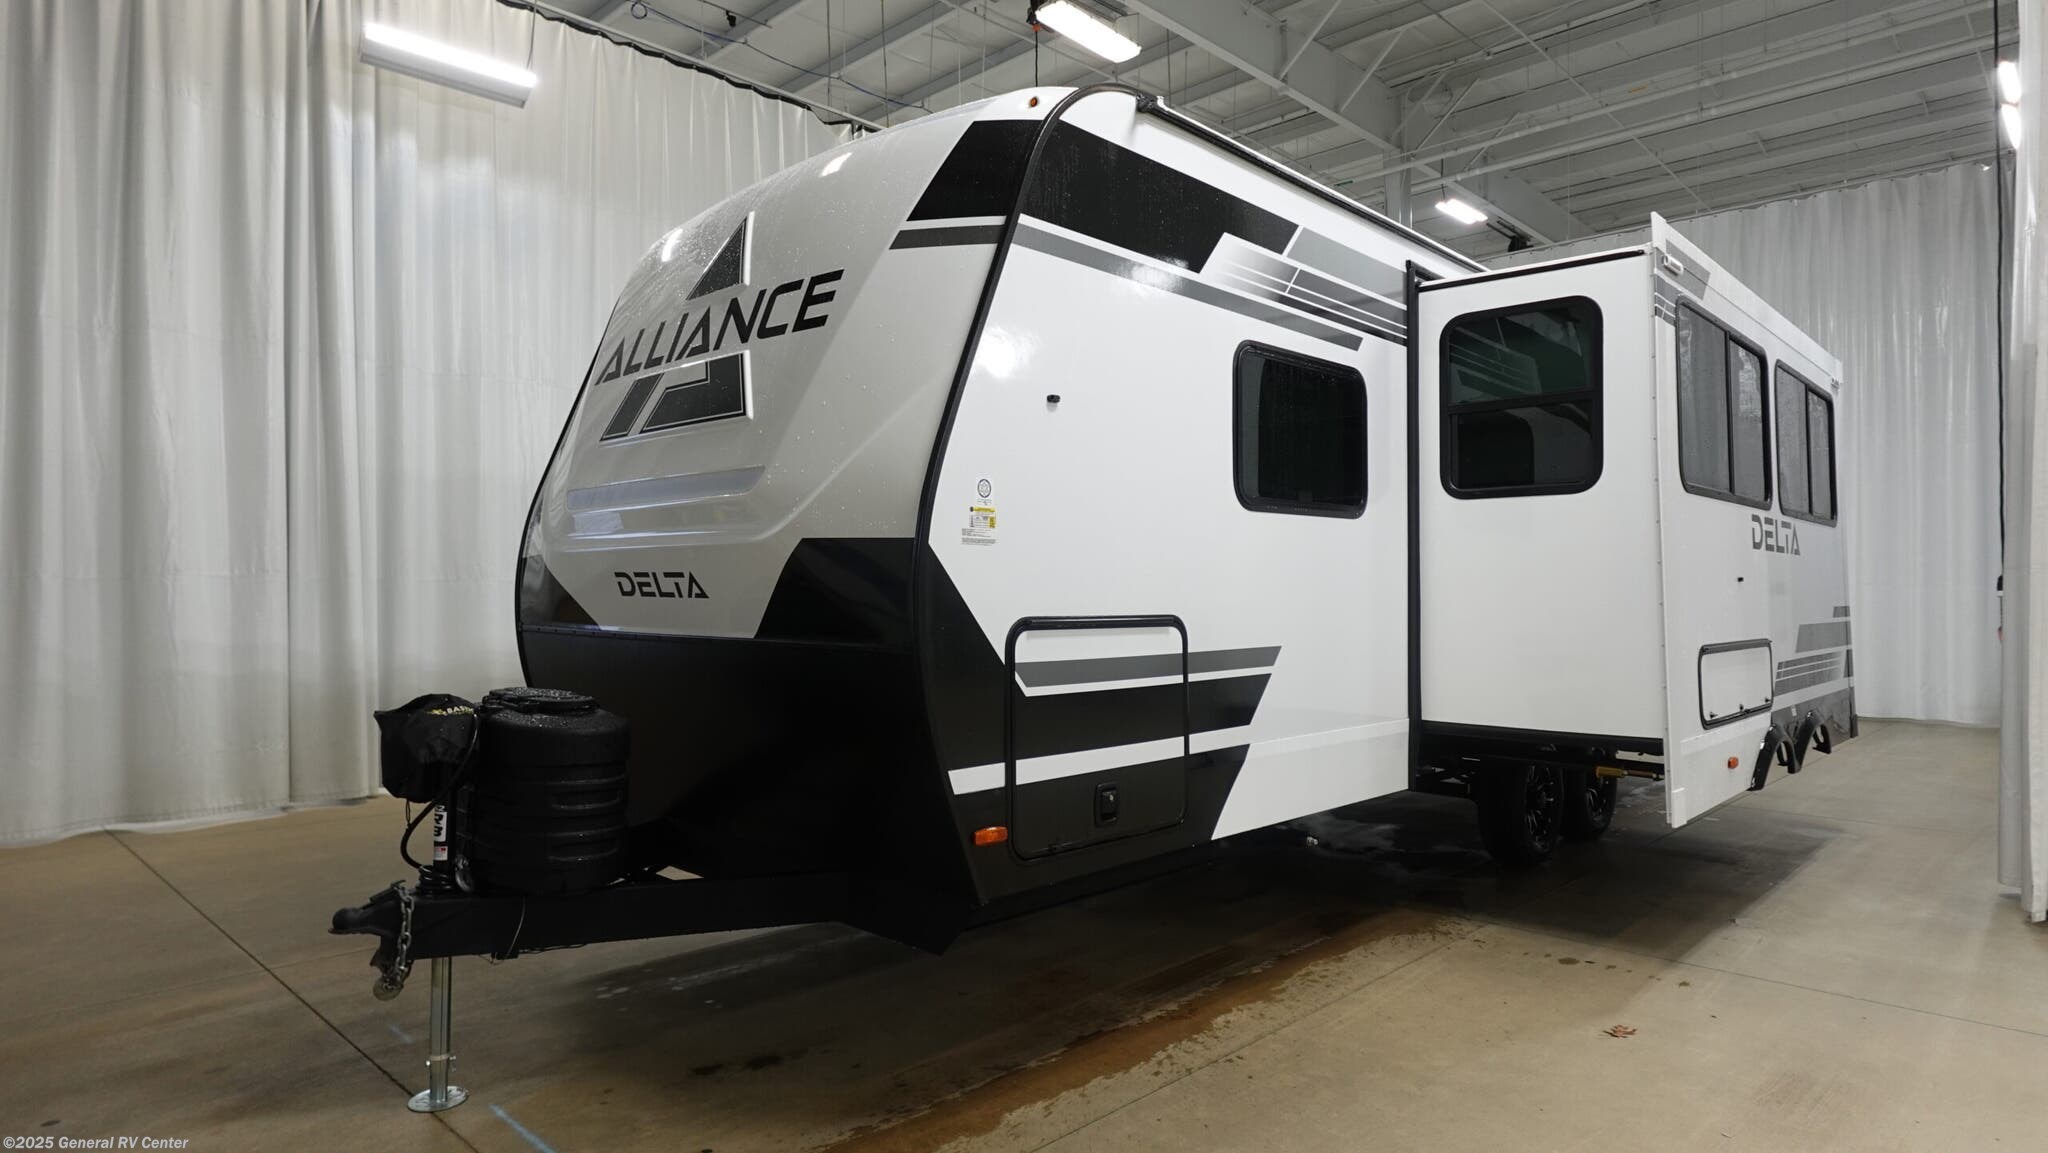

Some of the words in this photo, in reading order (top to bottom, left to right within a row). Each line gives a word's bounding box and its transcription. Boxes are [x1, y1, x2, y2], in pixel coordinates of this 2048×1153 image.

[594, 269, 845, 386] ALLIANCE
[1751, 514, 1801, 556] DELTA
[614, 571, 710, 599] DELTA
